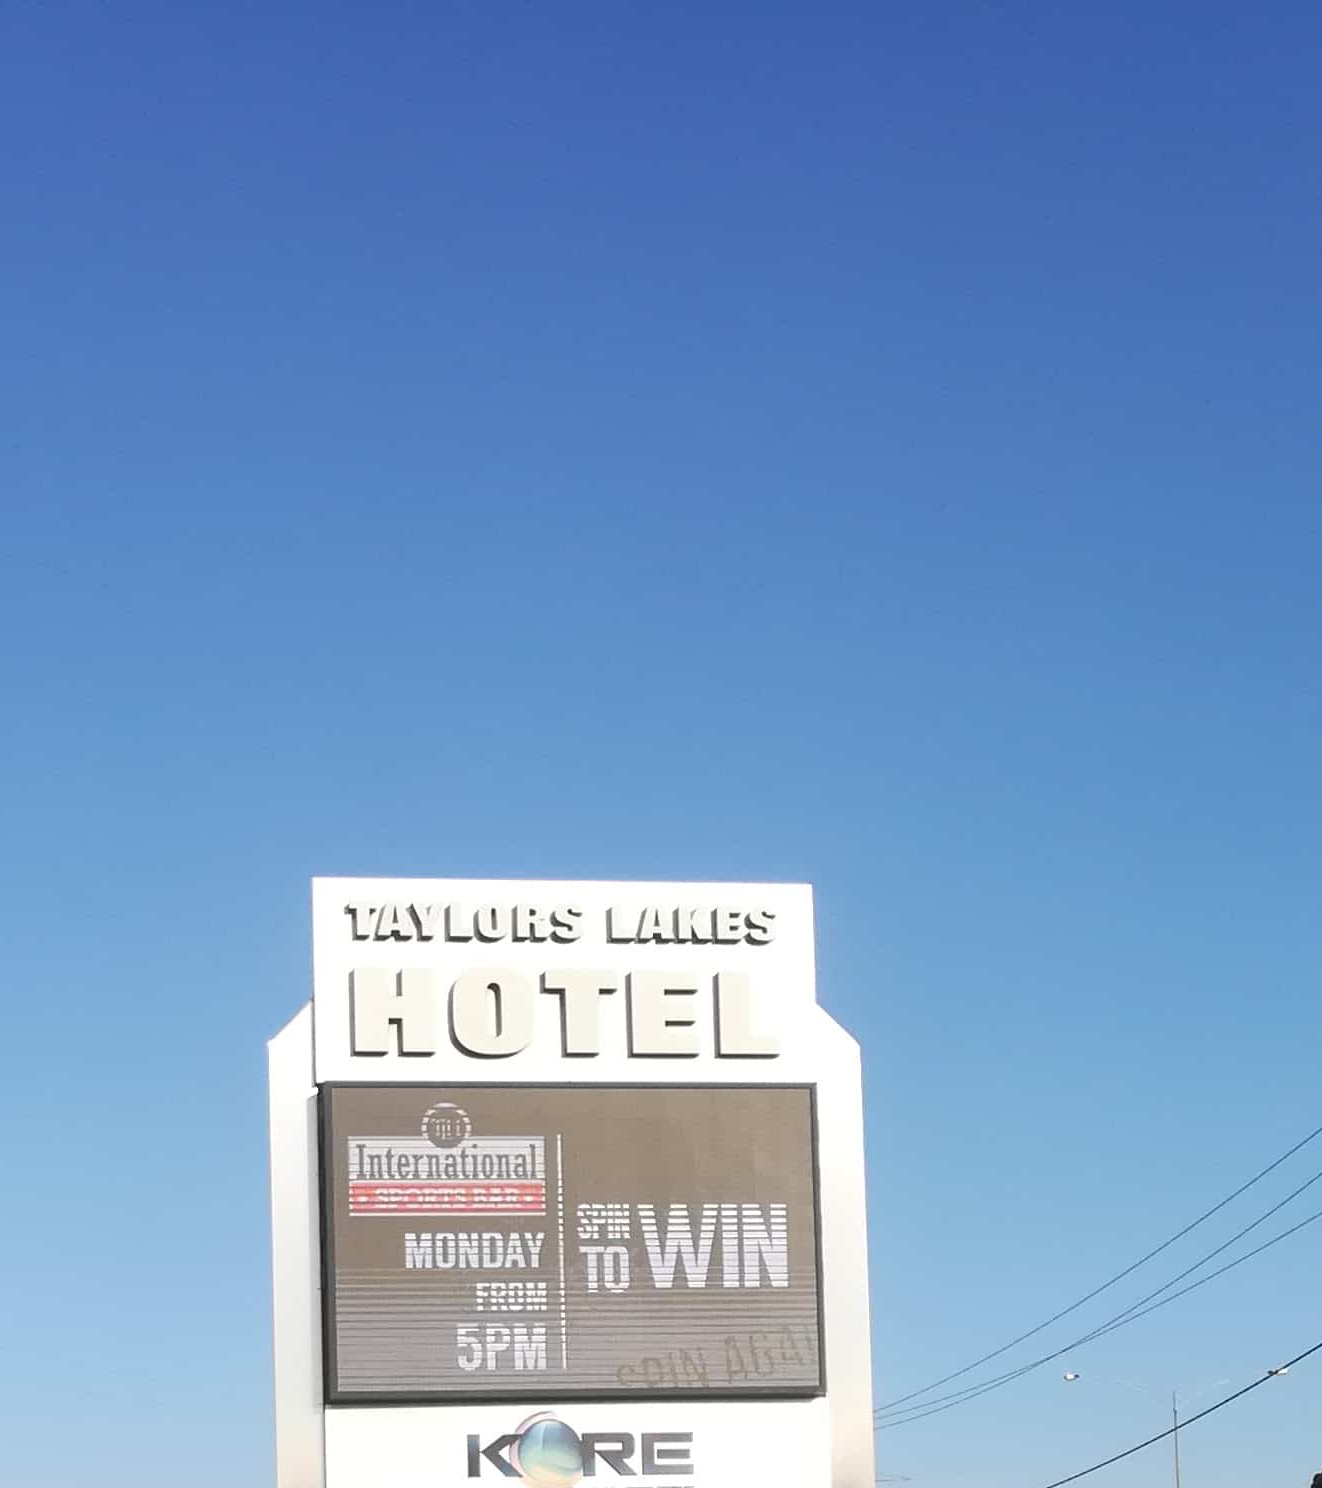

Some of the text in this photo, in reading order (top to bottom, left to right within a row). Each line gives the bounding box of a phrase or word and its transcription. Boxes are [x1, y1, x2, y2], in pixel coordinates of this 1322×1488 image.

[345, 901, 776, 946] TAYLORS LAKES
[348, 966, 781, 1060] HOTEL
[355, 1143, 537, 1180] International
[374, 1188, 522, 1209] SPORTS BAR
[576, 1203, 631, 1239] SPIN
[404, 1231, 545, 1269] MONDAY
[636, 1203, 790, 1289] WIN
[578, 1245, 630, 1293] TO
[476, 1281, 548, 1312] FROM
[456, 1322, 548, 1372] 5PM
[466, 1419, 695, 1481] KORE
